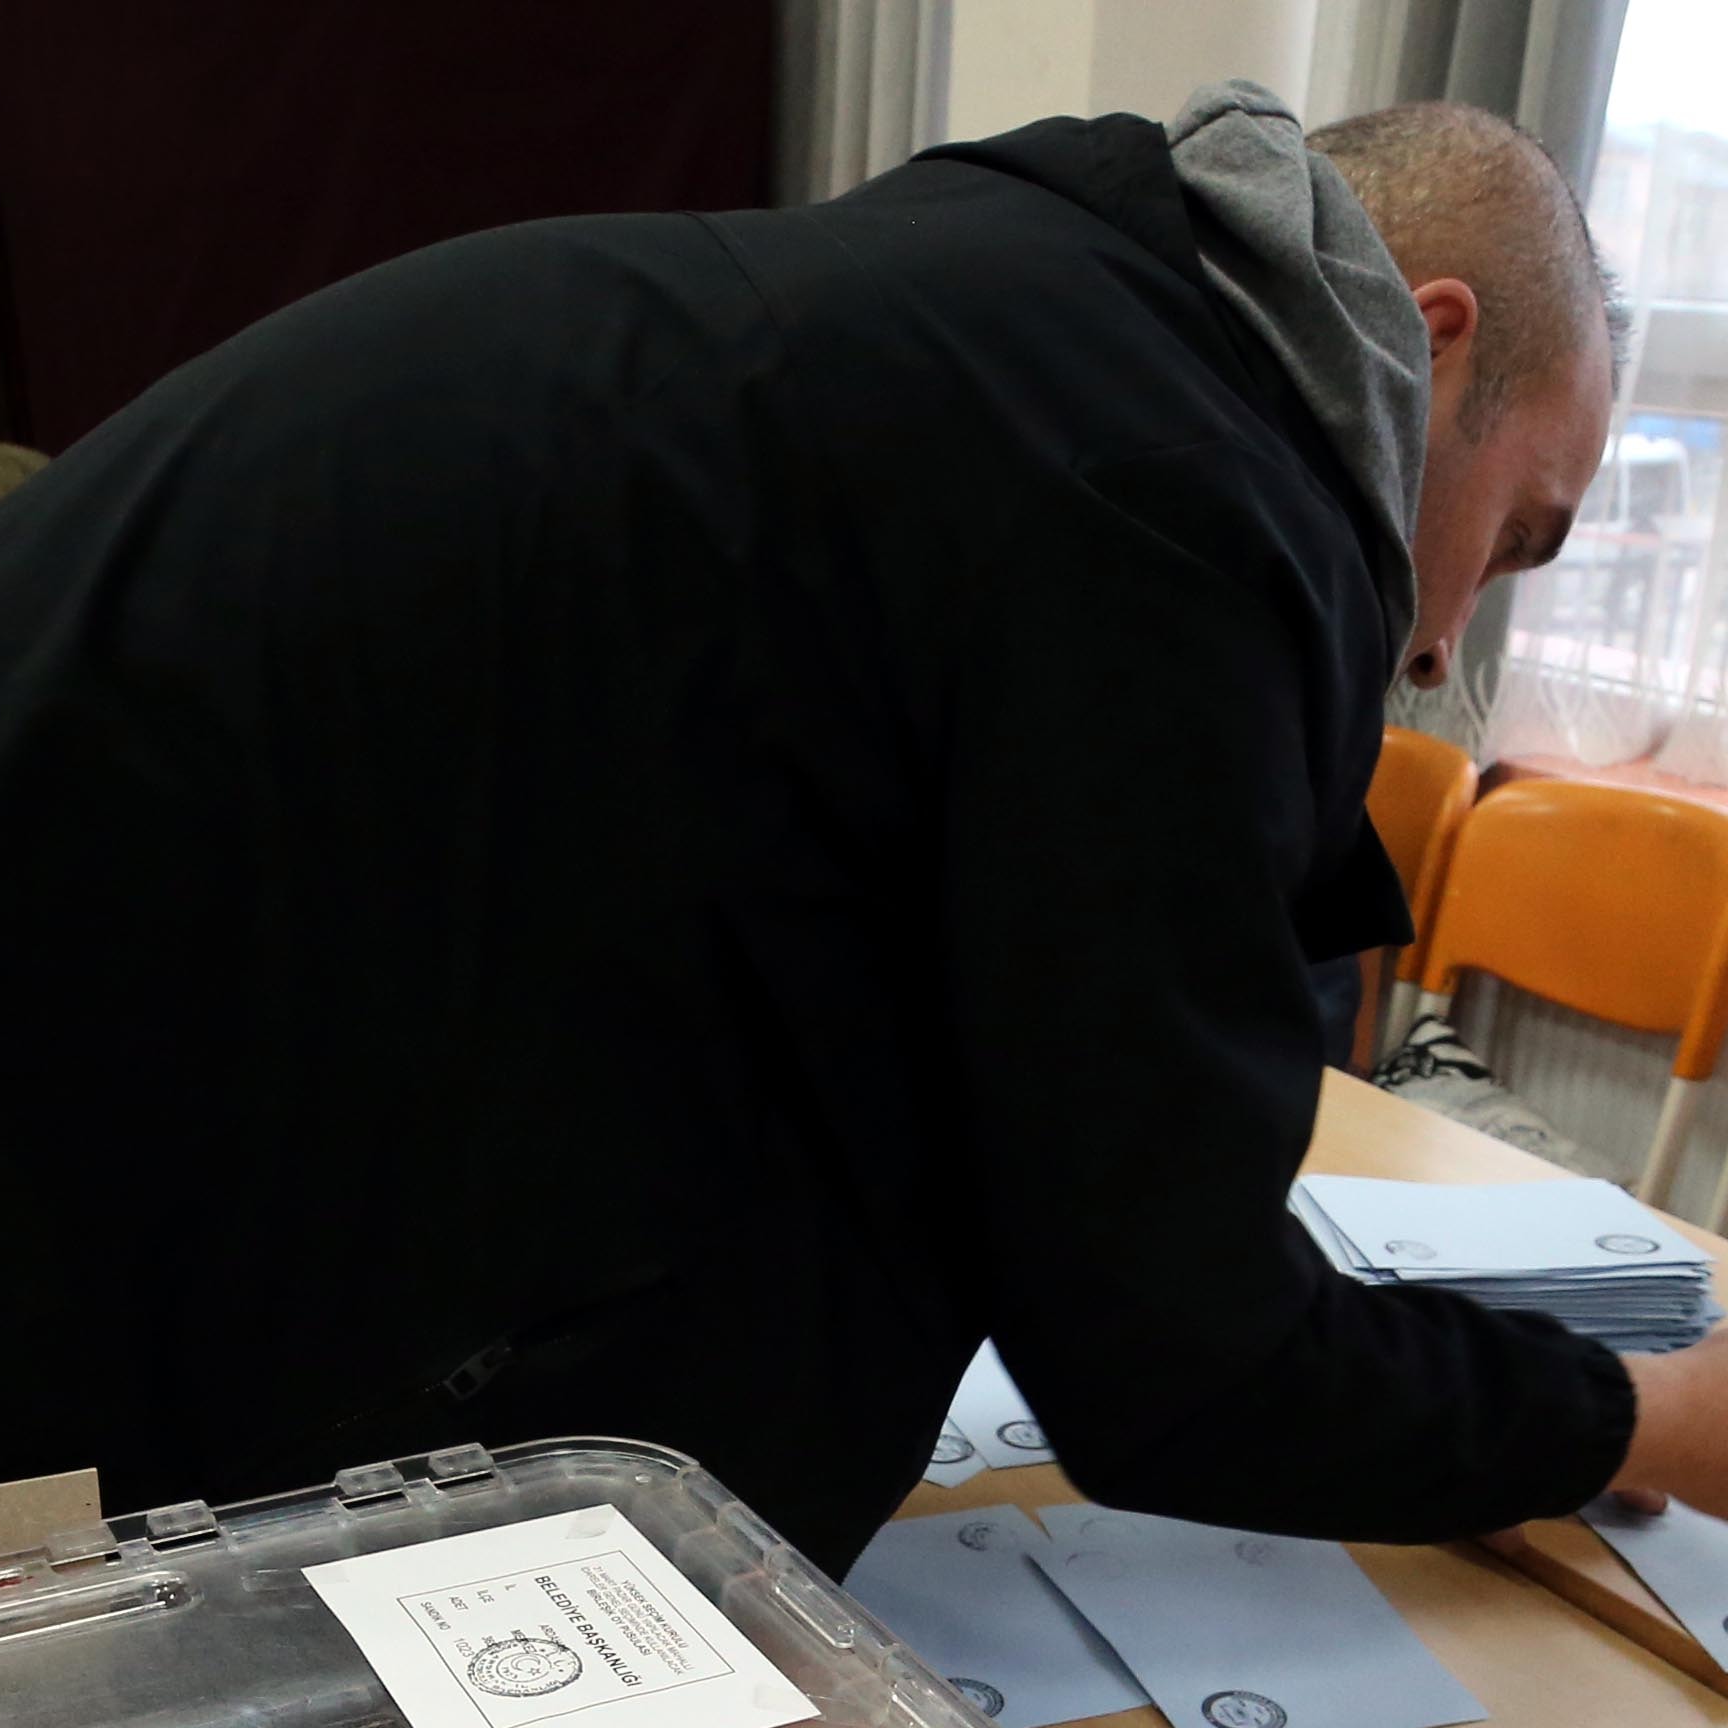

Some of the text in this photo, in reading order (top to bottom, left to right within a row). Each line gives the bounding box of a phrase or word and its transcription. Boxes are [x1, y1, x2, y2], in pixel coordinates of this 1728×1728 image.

[453, 1637, 478, 1658] 1023
[534, 1575, 642, 1687] BELEDİYE BAŞKANLIĞI
